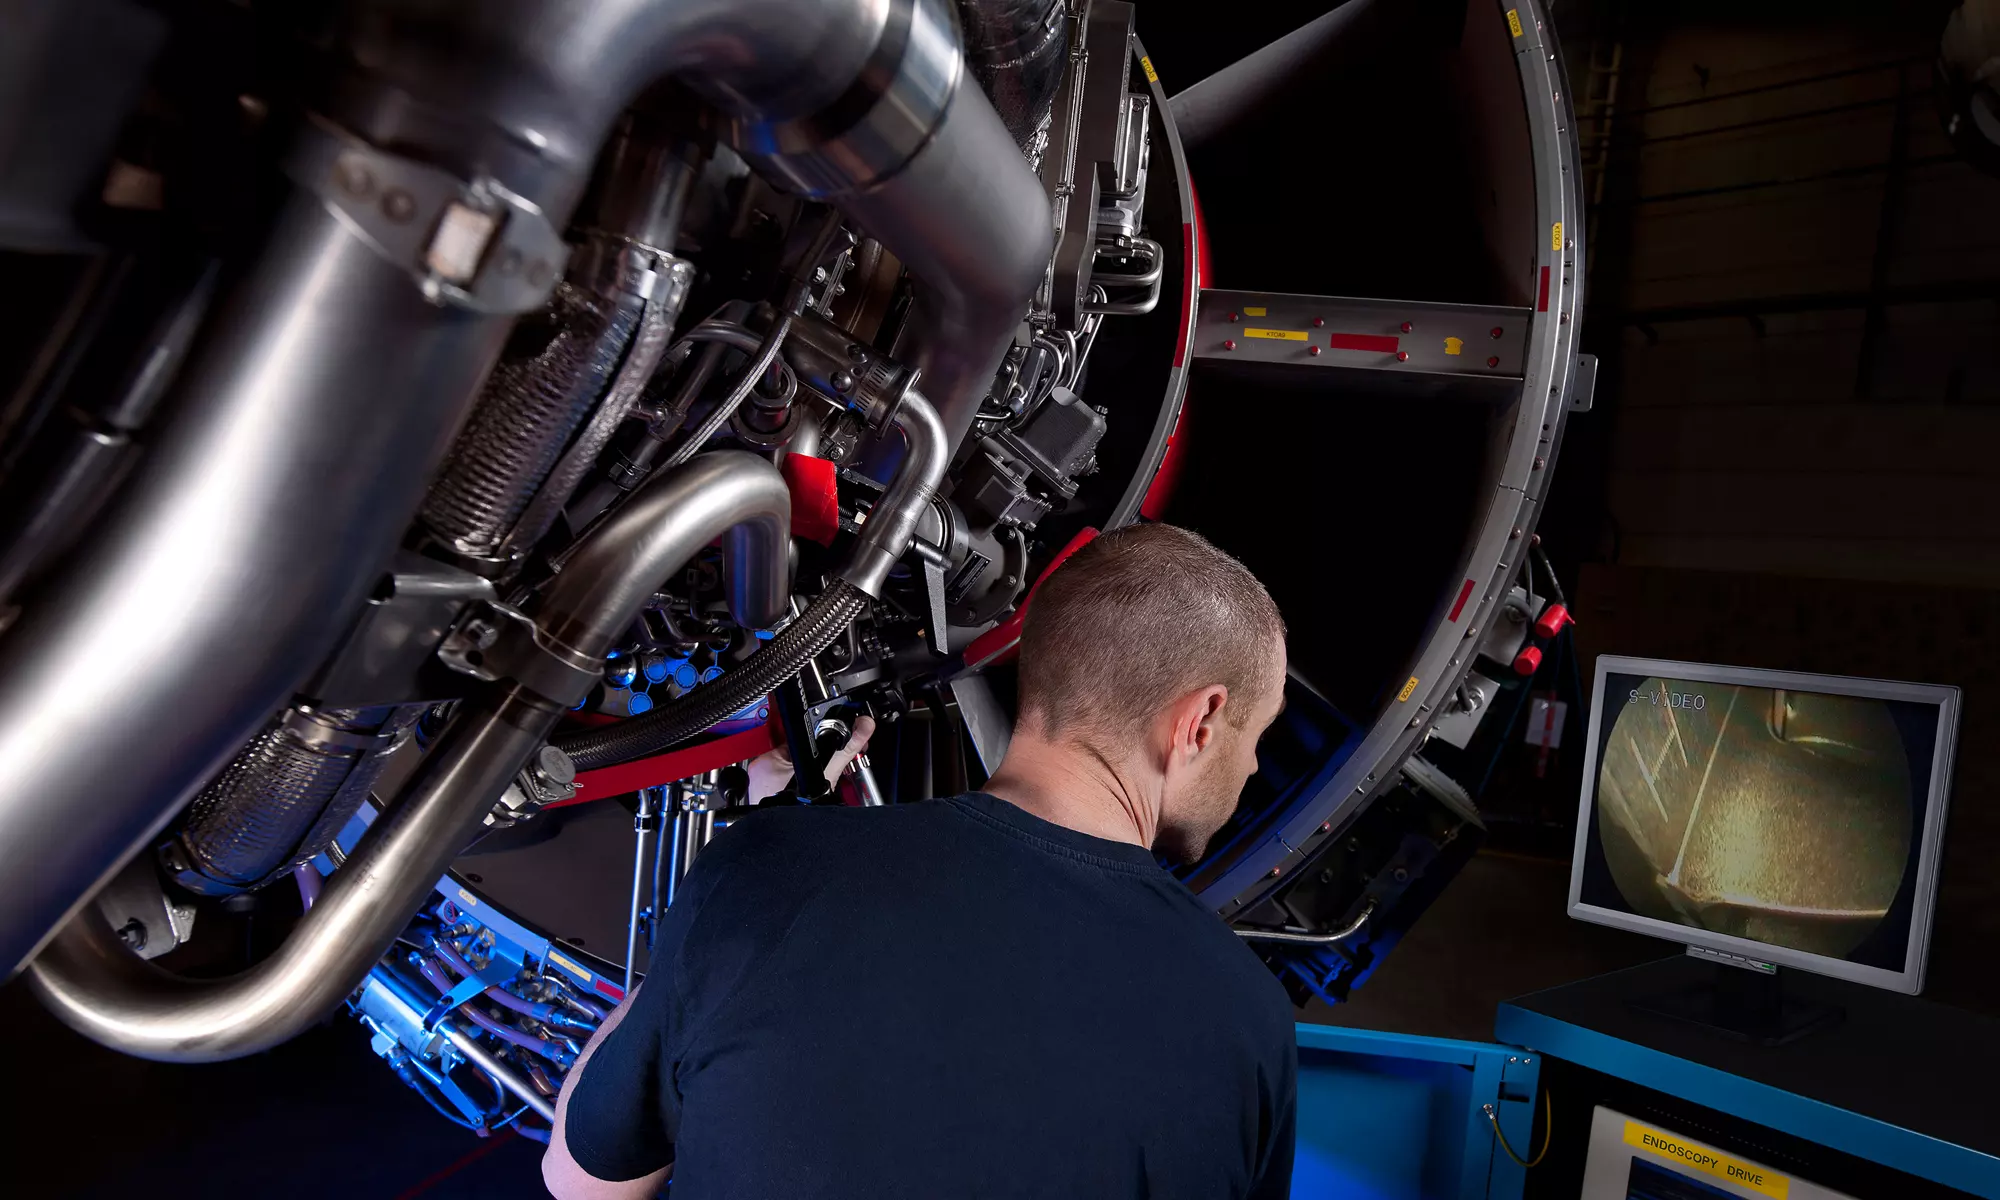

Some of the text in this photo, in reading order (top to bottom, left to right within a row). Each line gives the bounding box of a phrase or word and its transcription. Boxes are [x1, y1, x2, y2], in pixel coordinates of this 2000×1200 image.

[1628, 689, 1705, 710] S-VIDEO
[1642, 1133, 1763, 1186] ENDOSCOPY DRIVE
